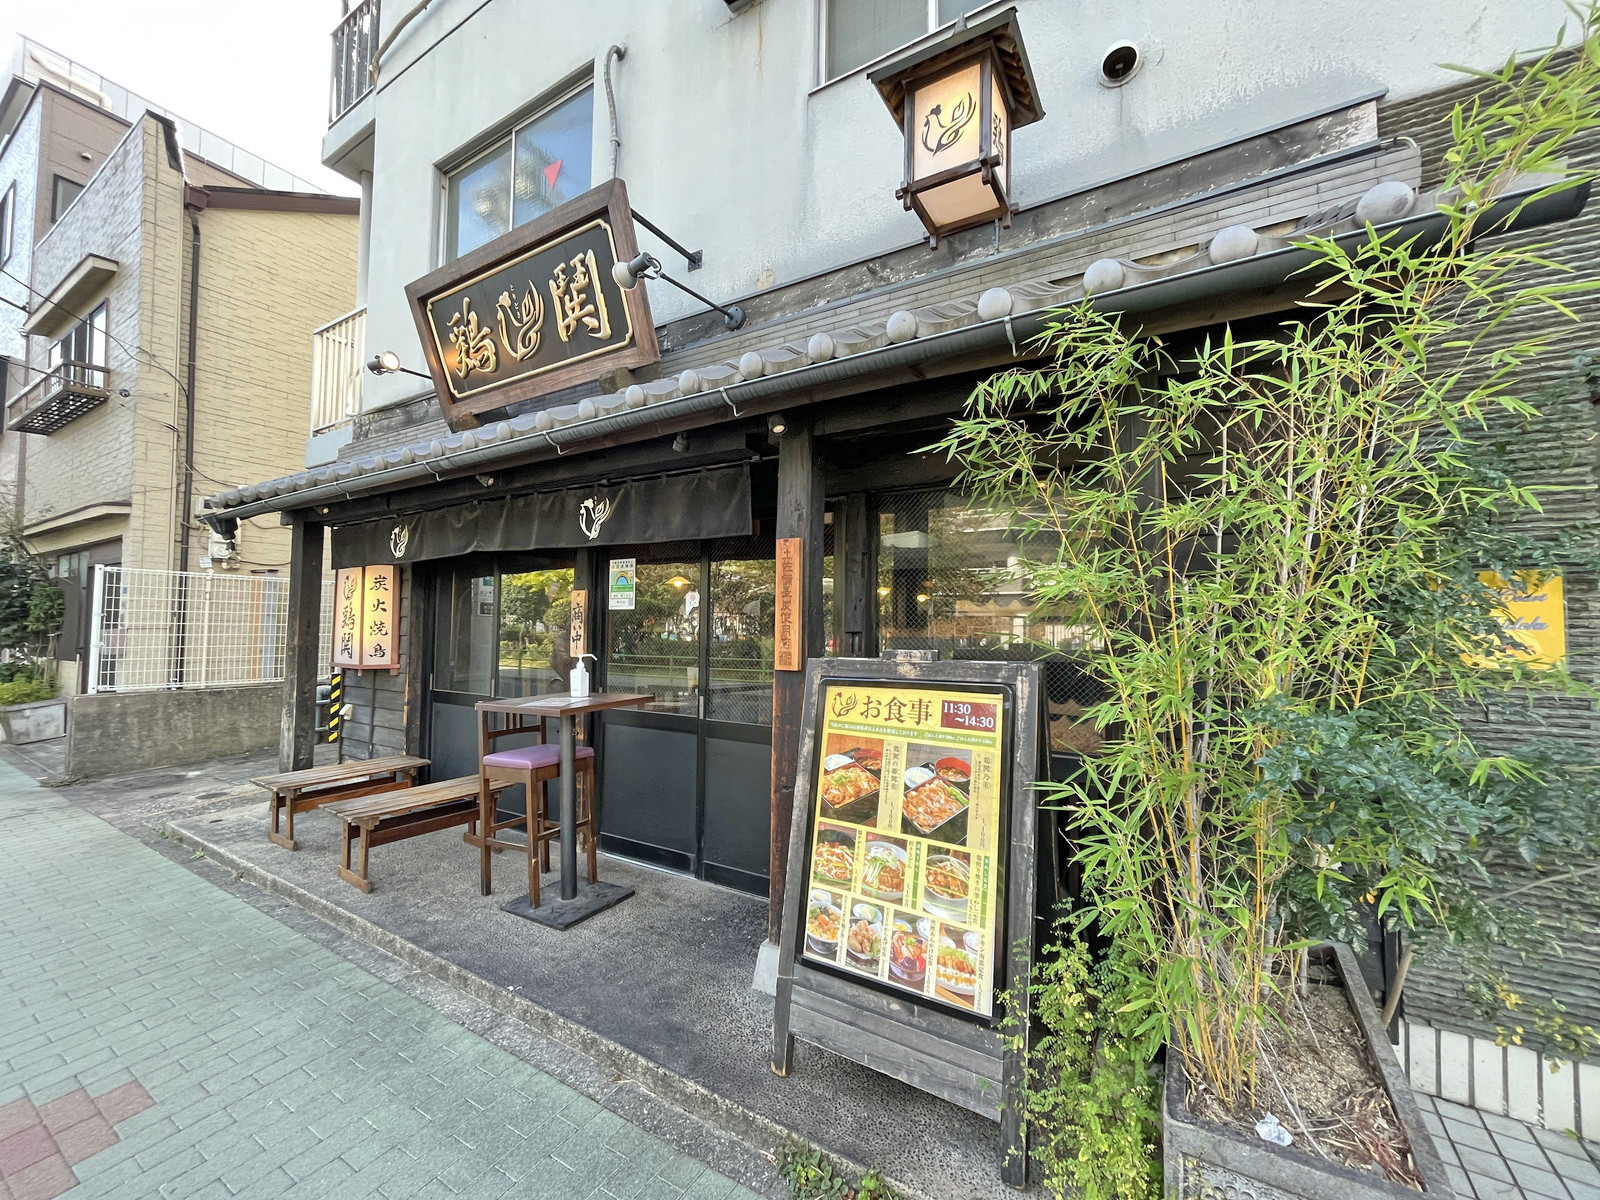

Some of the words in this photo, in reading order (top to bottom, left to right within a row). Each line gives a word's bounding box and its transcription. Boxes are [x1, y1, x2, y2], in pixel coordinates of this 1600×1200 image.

[369, 574, 389, 658] 炭火焼鳥
[571, 602, 583, 650] 商い中
[859, 695, 933, 726] お食事
[943, 701, 972, 715] 11:30
